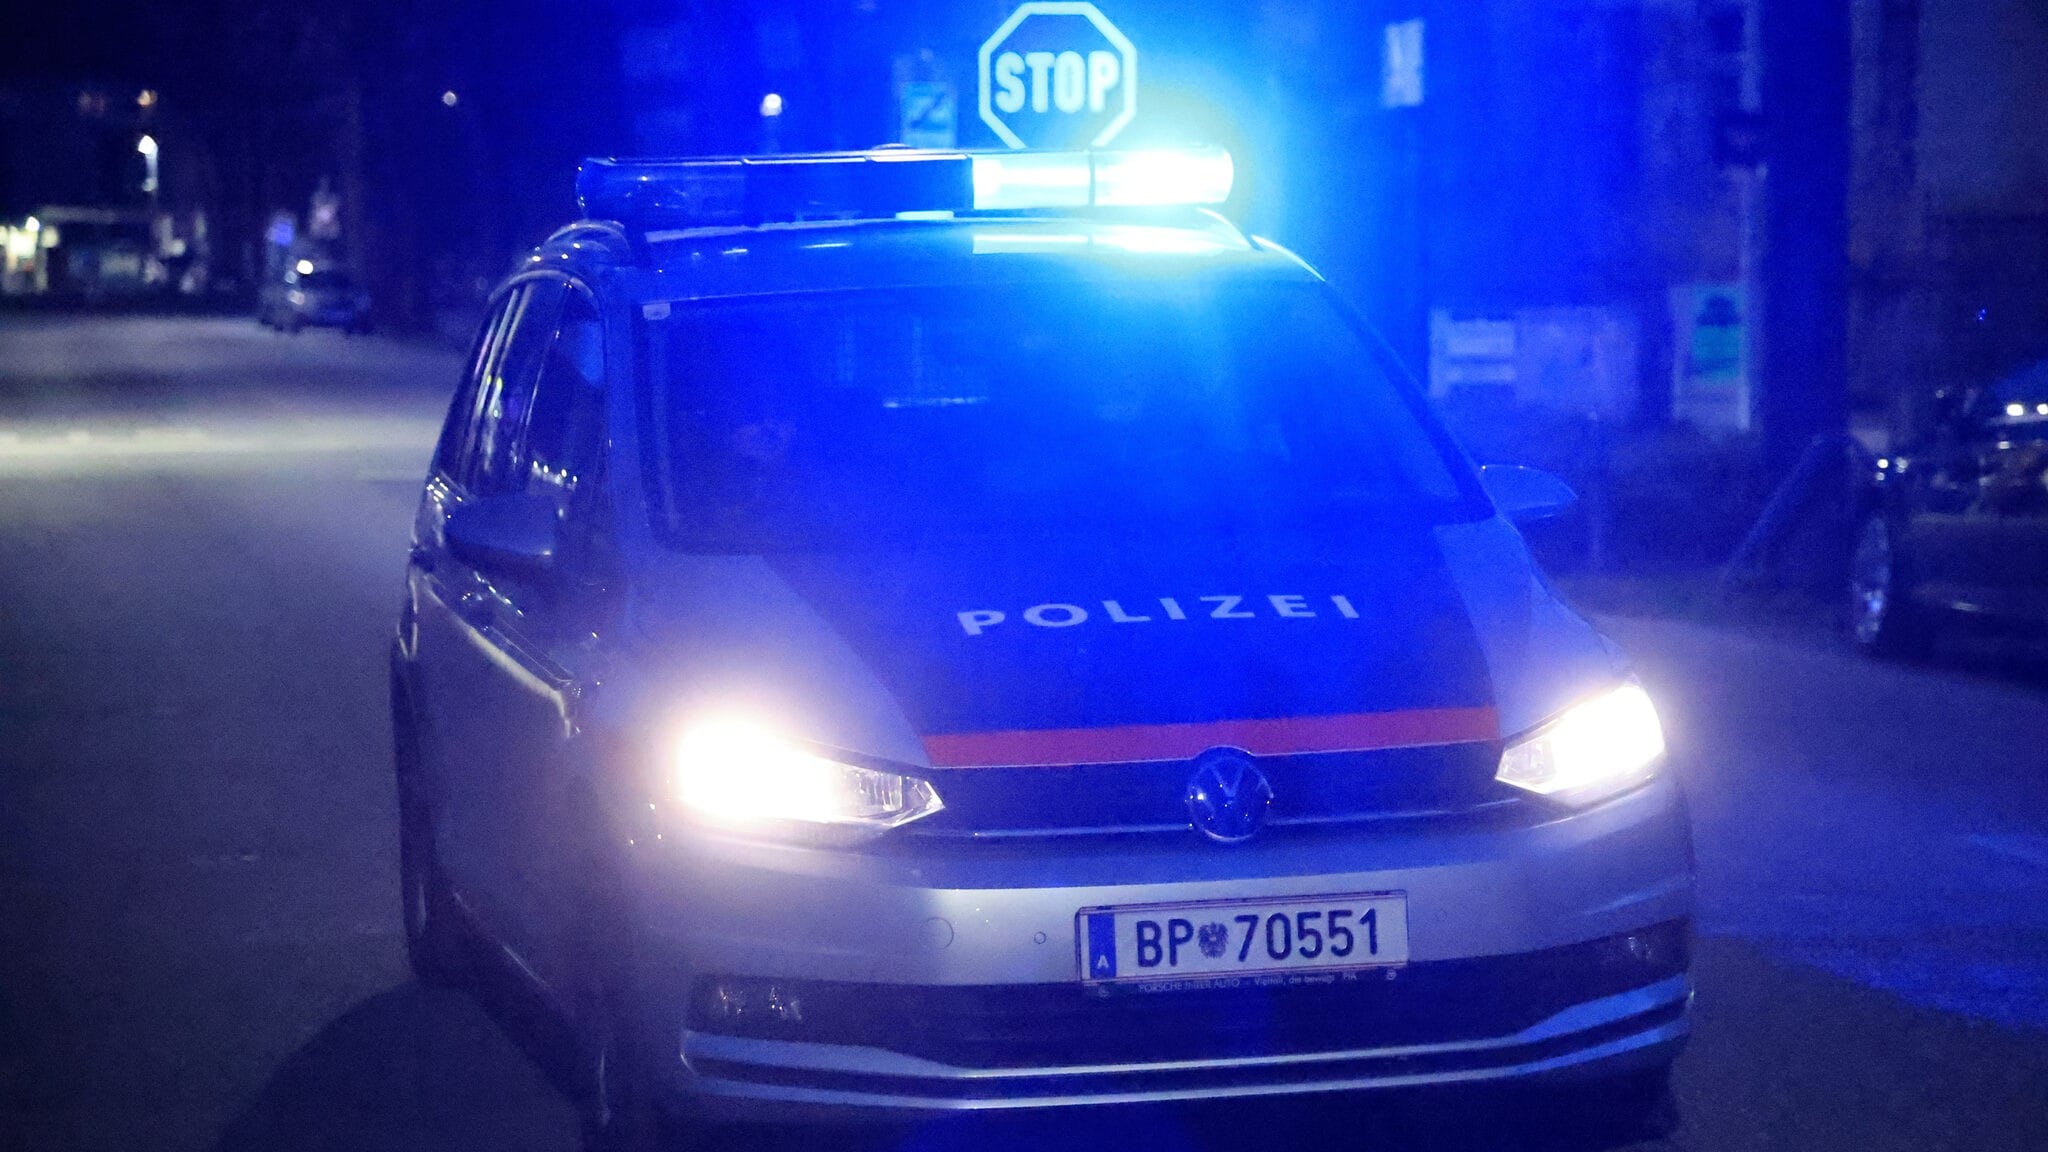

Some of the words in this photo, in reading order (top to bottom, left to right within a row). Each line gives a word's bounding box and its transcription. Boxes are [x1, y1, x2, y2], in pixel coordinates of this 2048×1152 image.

[995, 50, 1120, 114] STOP
[956, 594, 1361, 636] POLIZEI
[1097, 954, 1109, 969] A
[1135, 918, 1194, 968] BP
[1233, 908, 1378, 963] 70551
